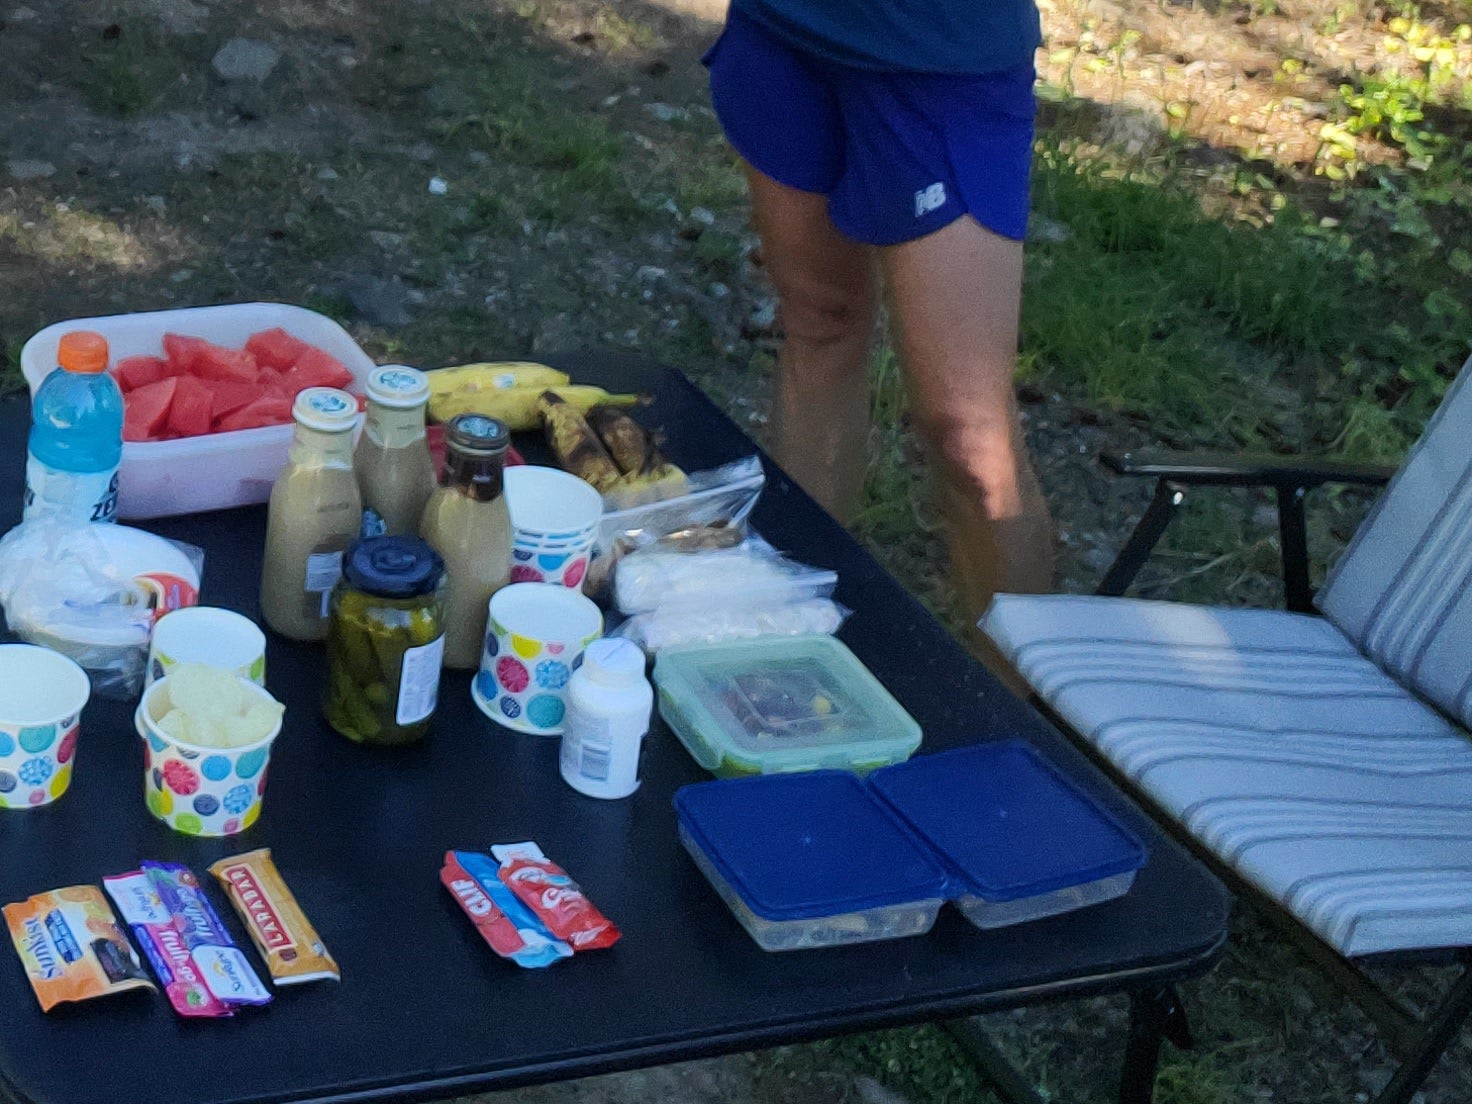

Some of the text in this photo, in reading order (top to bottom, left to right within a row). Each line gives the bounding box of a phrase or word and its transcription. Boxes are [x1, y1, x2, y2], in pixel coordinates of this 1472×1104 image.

[230, 870, 284, 945] LARABAR
[451, 879, 493, 916] CLIF
[23, 914, 61, 980] Sunkist
